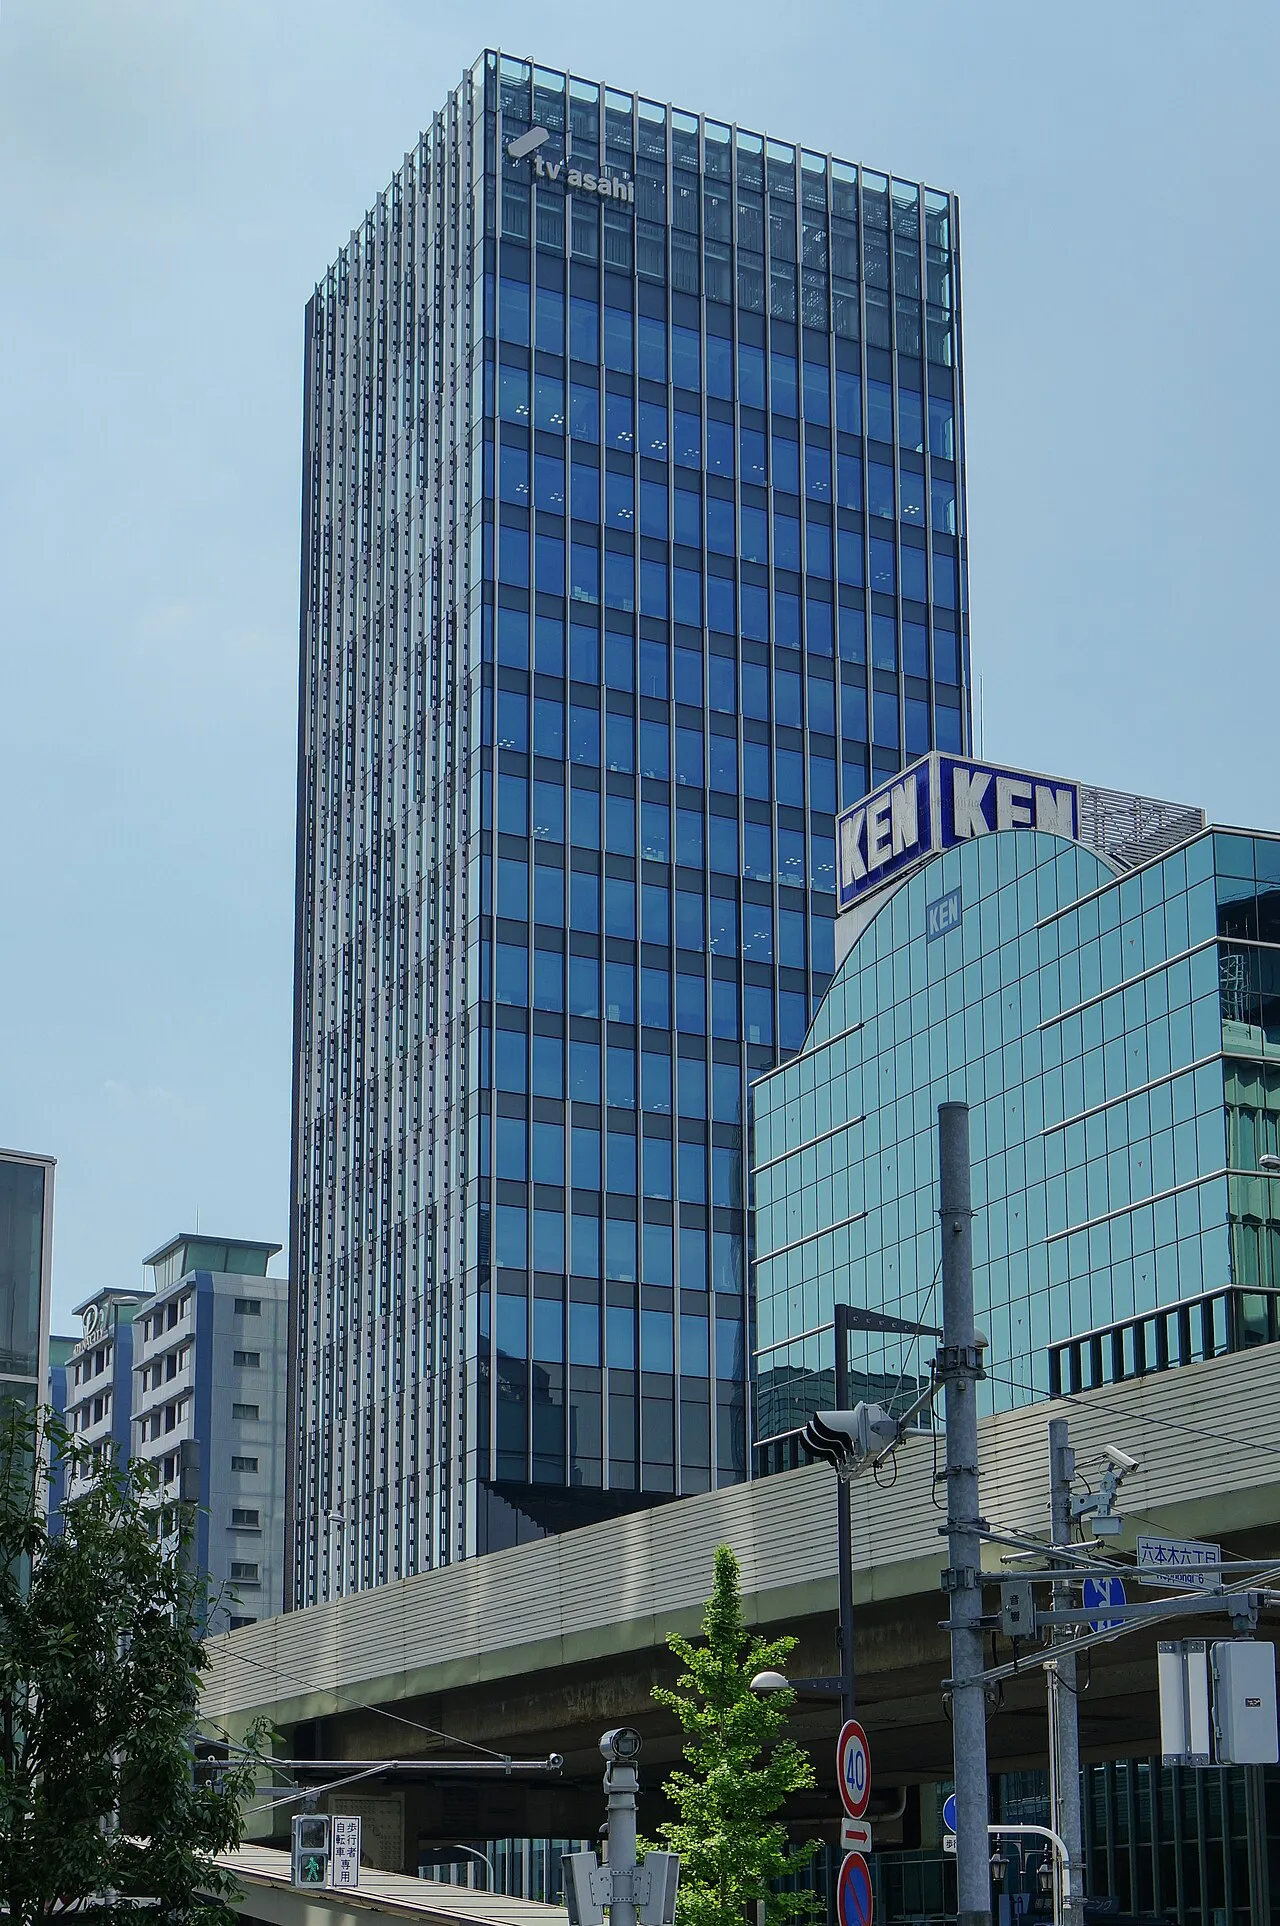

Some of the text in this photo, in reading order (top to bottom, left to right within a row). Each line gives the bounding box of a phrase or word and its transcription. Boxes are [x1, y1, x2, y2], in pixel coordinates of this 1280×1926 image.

[534, 154, 634, 203] tv asahi
[953, 767, 1073, 840] KEN
[841, 774, 918, 889] KEN
[929, 895, 958, 935] KEN
[1141, 1543, 1216, 1565] 六本木六丁目
[1199, 1574, 1204, 1584] 6
[846, 1748, 864, 1792] 40
[336, 1823, 346, 1858] 自転車
[347, 1823, 357, 1858] 歩行者
[341, 1860, 351, 1883] 専用
